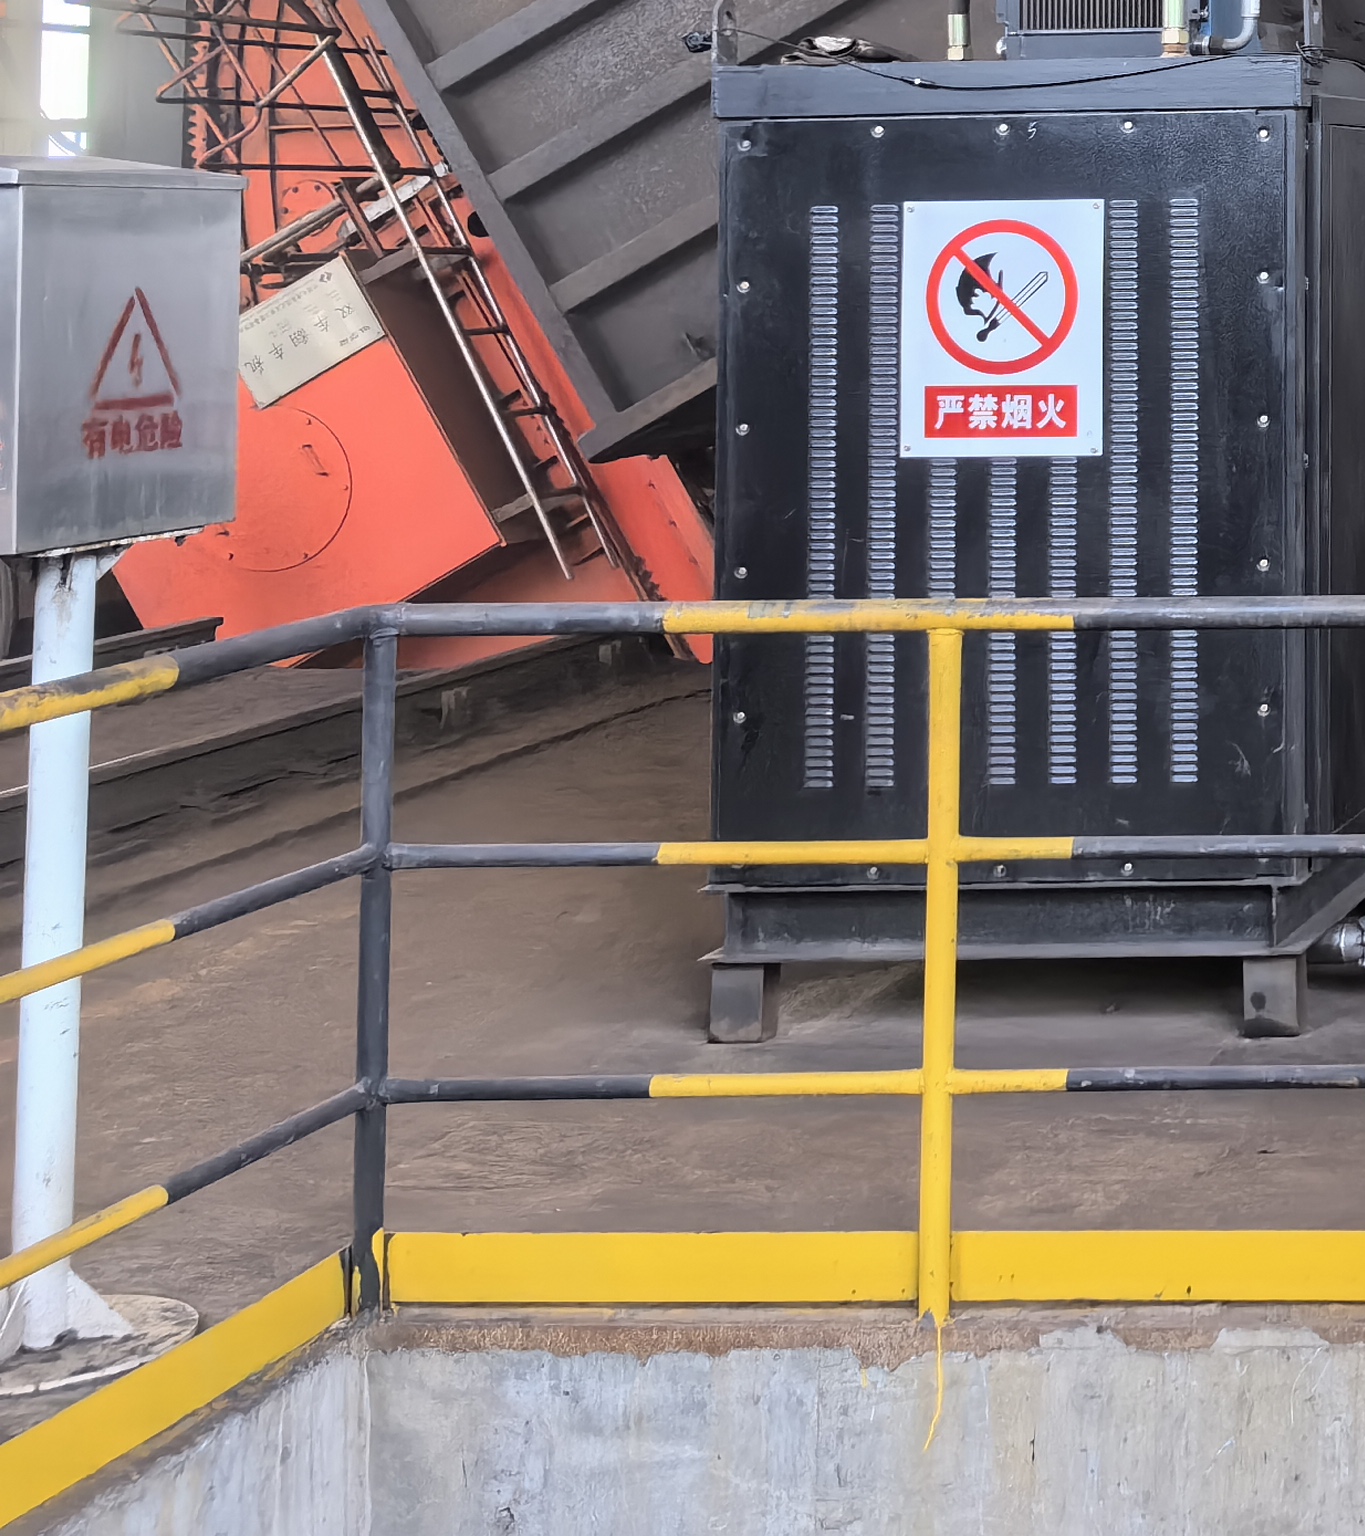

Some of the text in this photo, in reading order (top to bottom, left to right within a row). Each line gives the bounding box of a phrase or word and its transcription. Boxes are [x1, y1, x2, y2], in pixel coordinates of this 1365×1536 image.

[934, 394, 1067, 430] 严禁烟火
[82, 411, 183, 460] 有电危险
